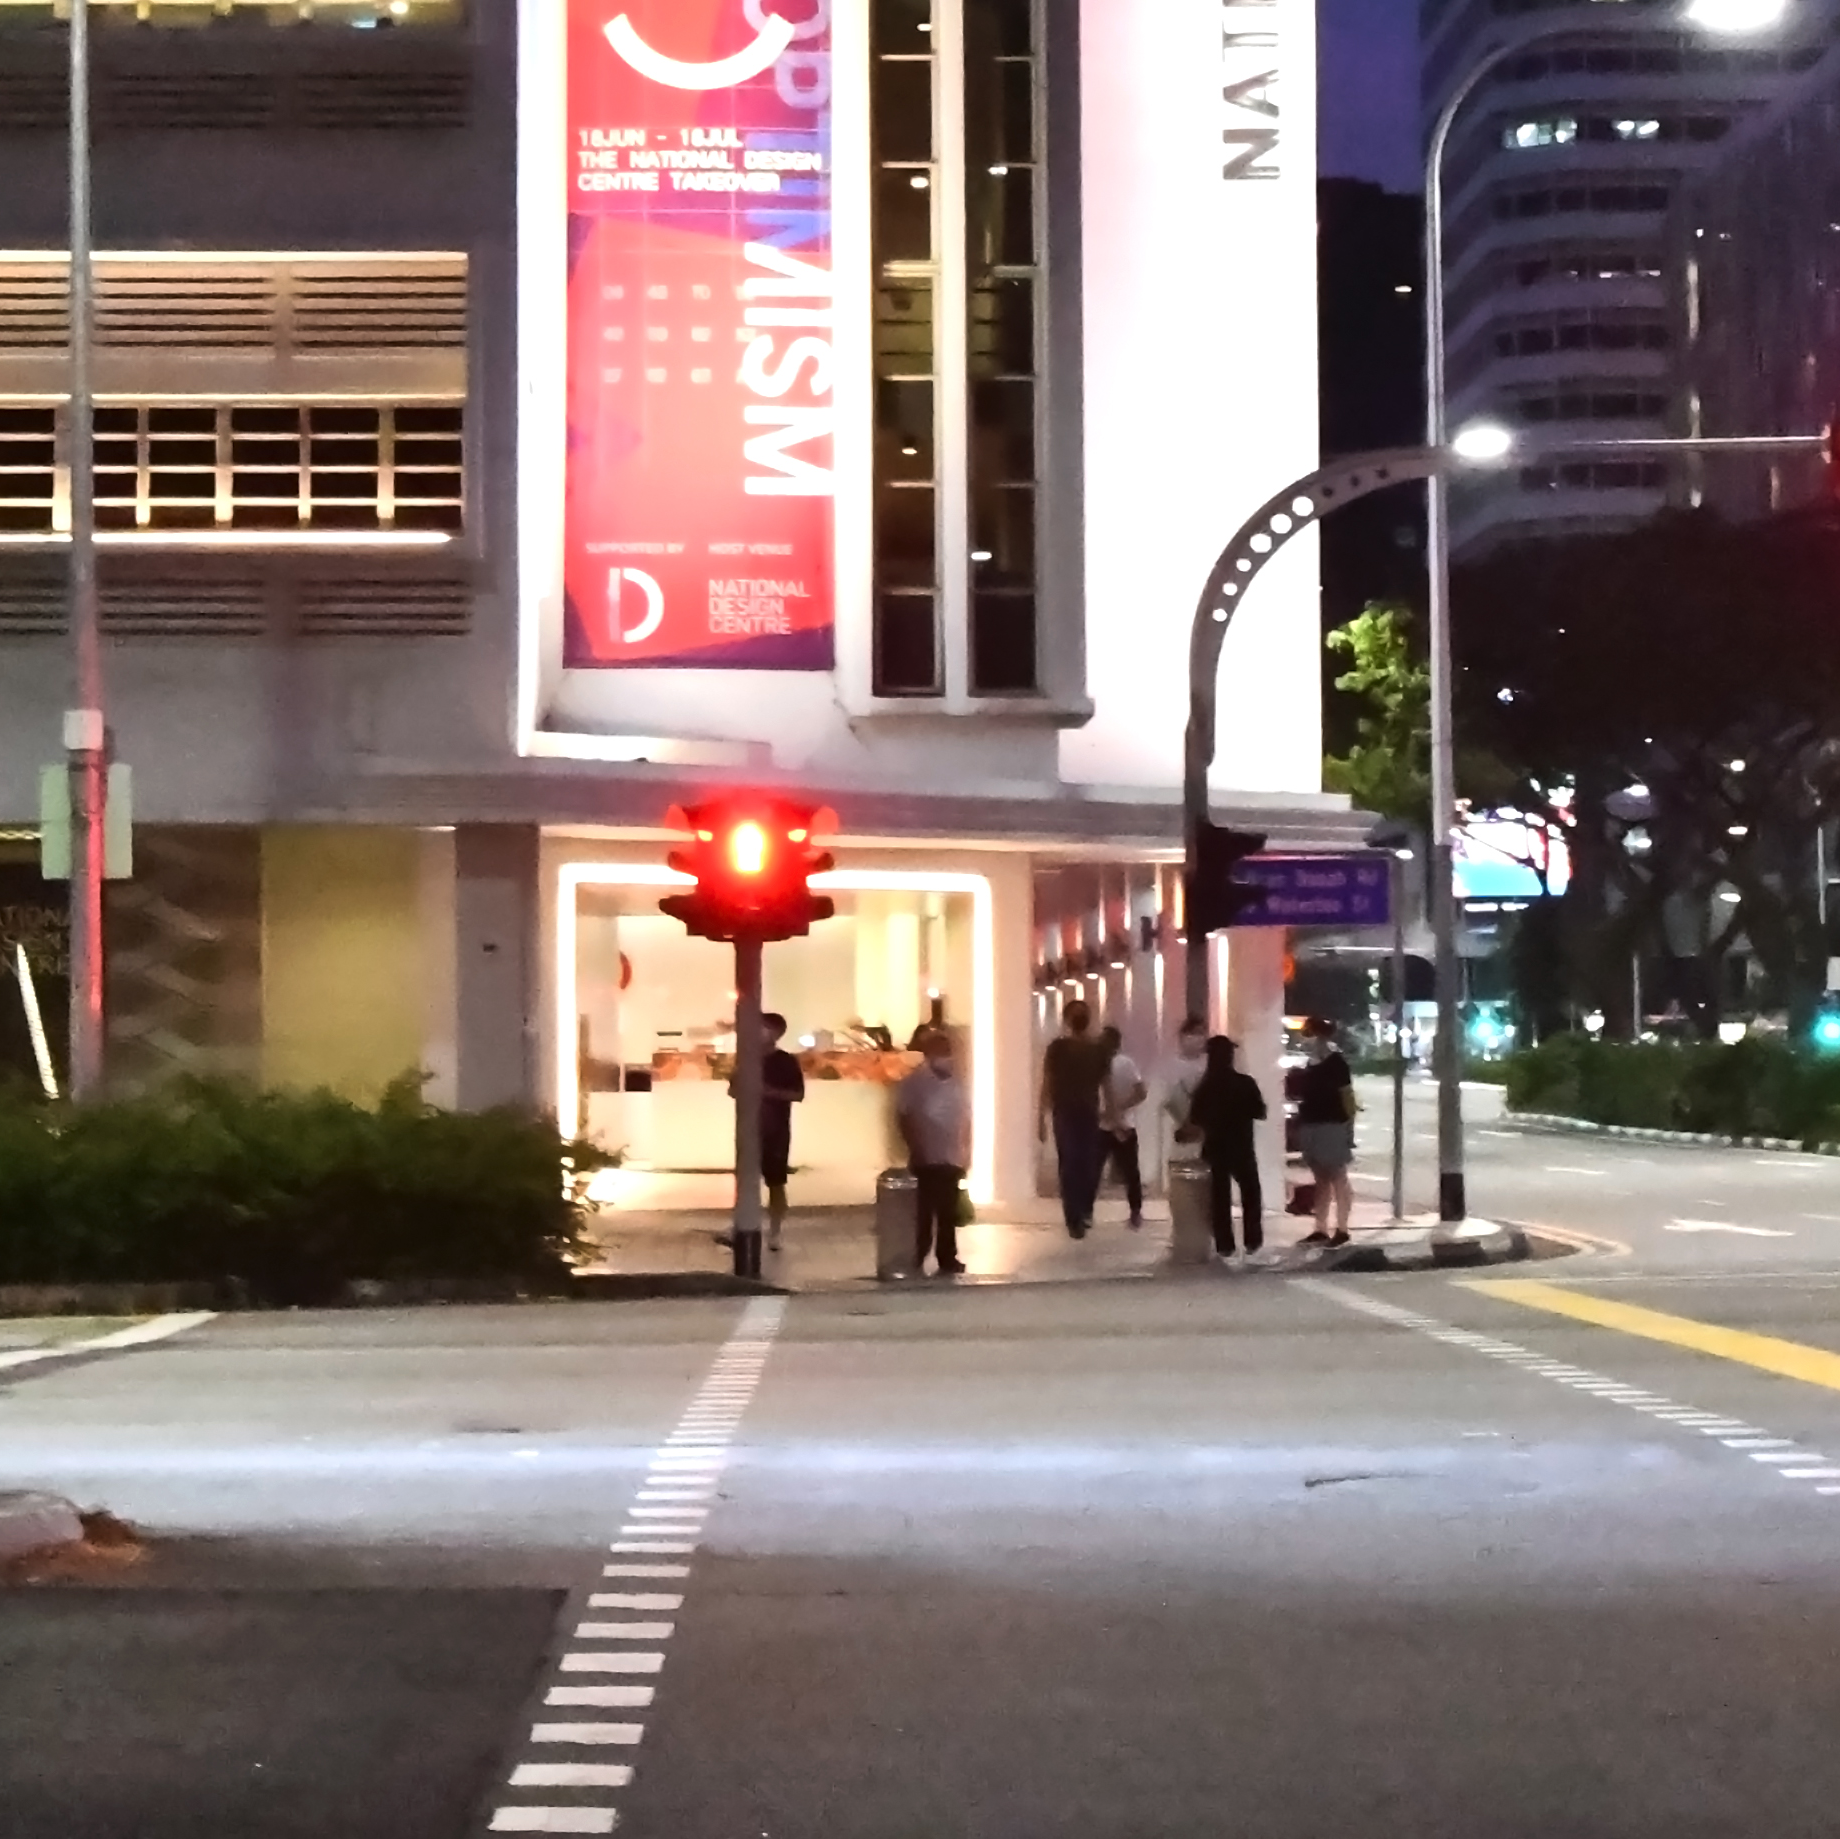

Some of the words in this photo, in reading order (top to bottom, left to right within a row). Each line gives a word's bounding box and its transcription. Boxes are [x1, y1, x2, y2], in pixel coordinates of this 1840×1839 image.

[577, 151, 618, 169] THE
[629, 150, 735, 170] NATIONAL
[743, 151, 823, 171] DESIGN
[577, 173, 660, 192] CENTRE
[669, 172, 782, 192] TAKEOVER
[708, 578, 811, 598] NATIONAL
[708, 597, 786, 616] DESIGN
[708, 616, 793, 635] CENTRE
